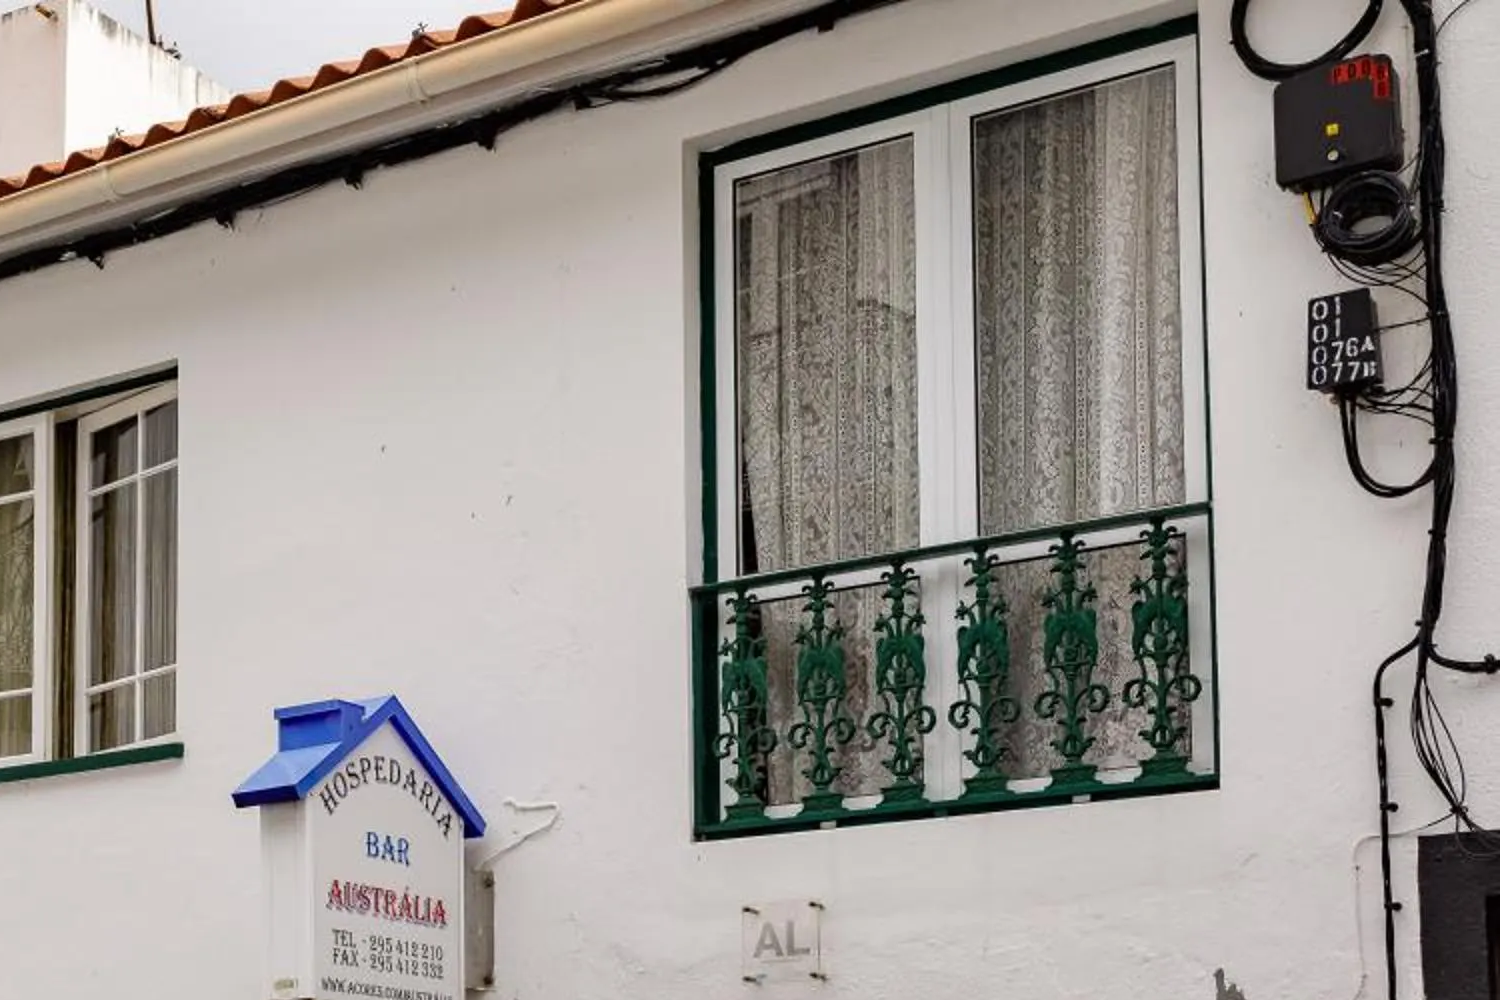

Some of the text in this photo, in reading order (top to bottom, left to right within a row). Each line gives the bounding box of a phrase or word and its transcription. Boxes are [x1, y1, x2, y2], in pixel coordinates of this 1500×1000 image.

[1312, 296, 1341, 320] 01
[1312, 317, 1341, 343] 01
[1312, 335, 1376, 365] 076A
[318, 755, 453, 838] HOSPEDARIA
[365, 831, 411, 867] BAR
[327, 878, 448, 928] AUSTRÁLIA
[369, 935, 394, 954] 295
[395, 939, 419, 959] 412
[421, 944, 444, 962] 210
[752, 920, 811, 958] AL
[332, 947, 360, 967] FAX
[369, 953, 394, 973] 295
[395, 957, 419, 977] 412
